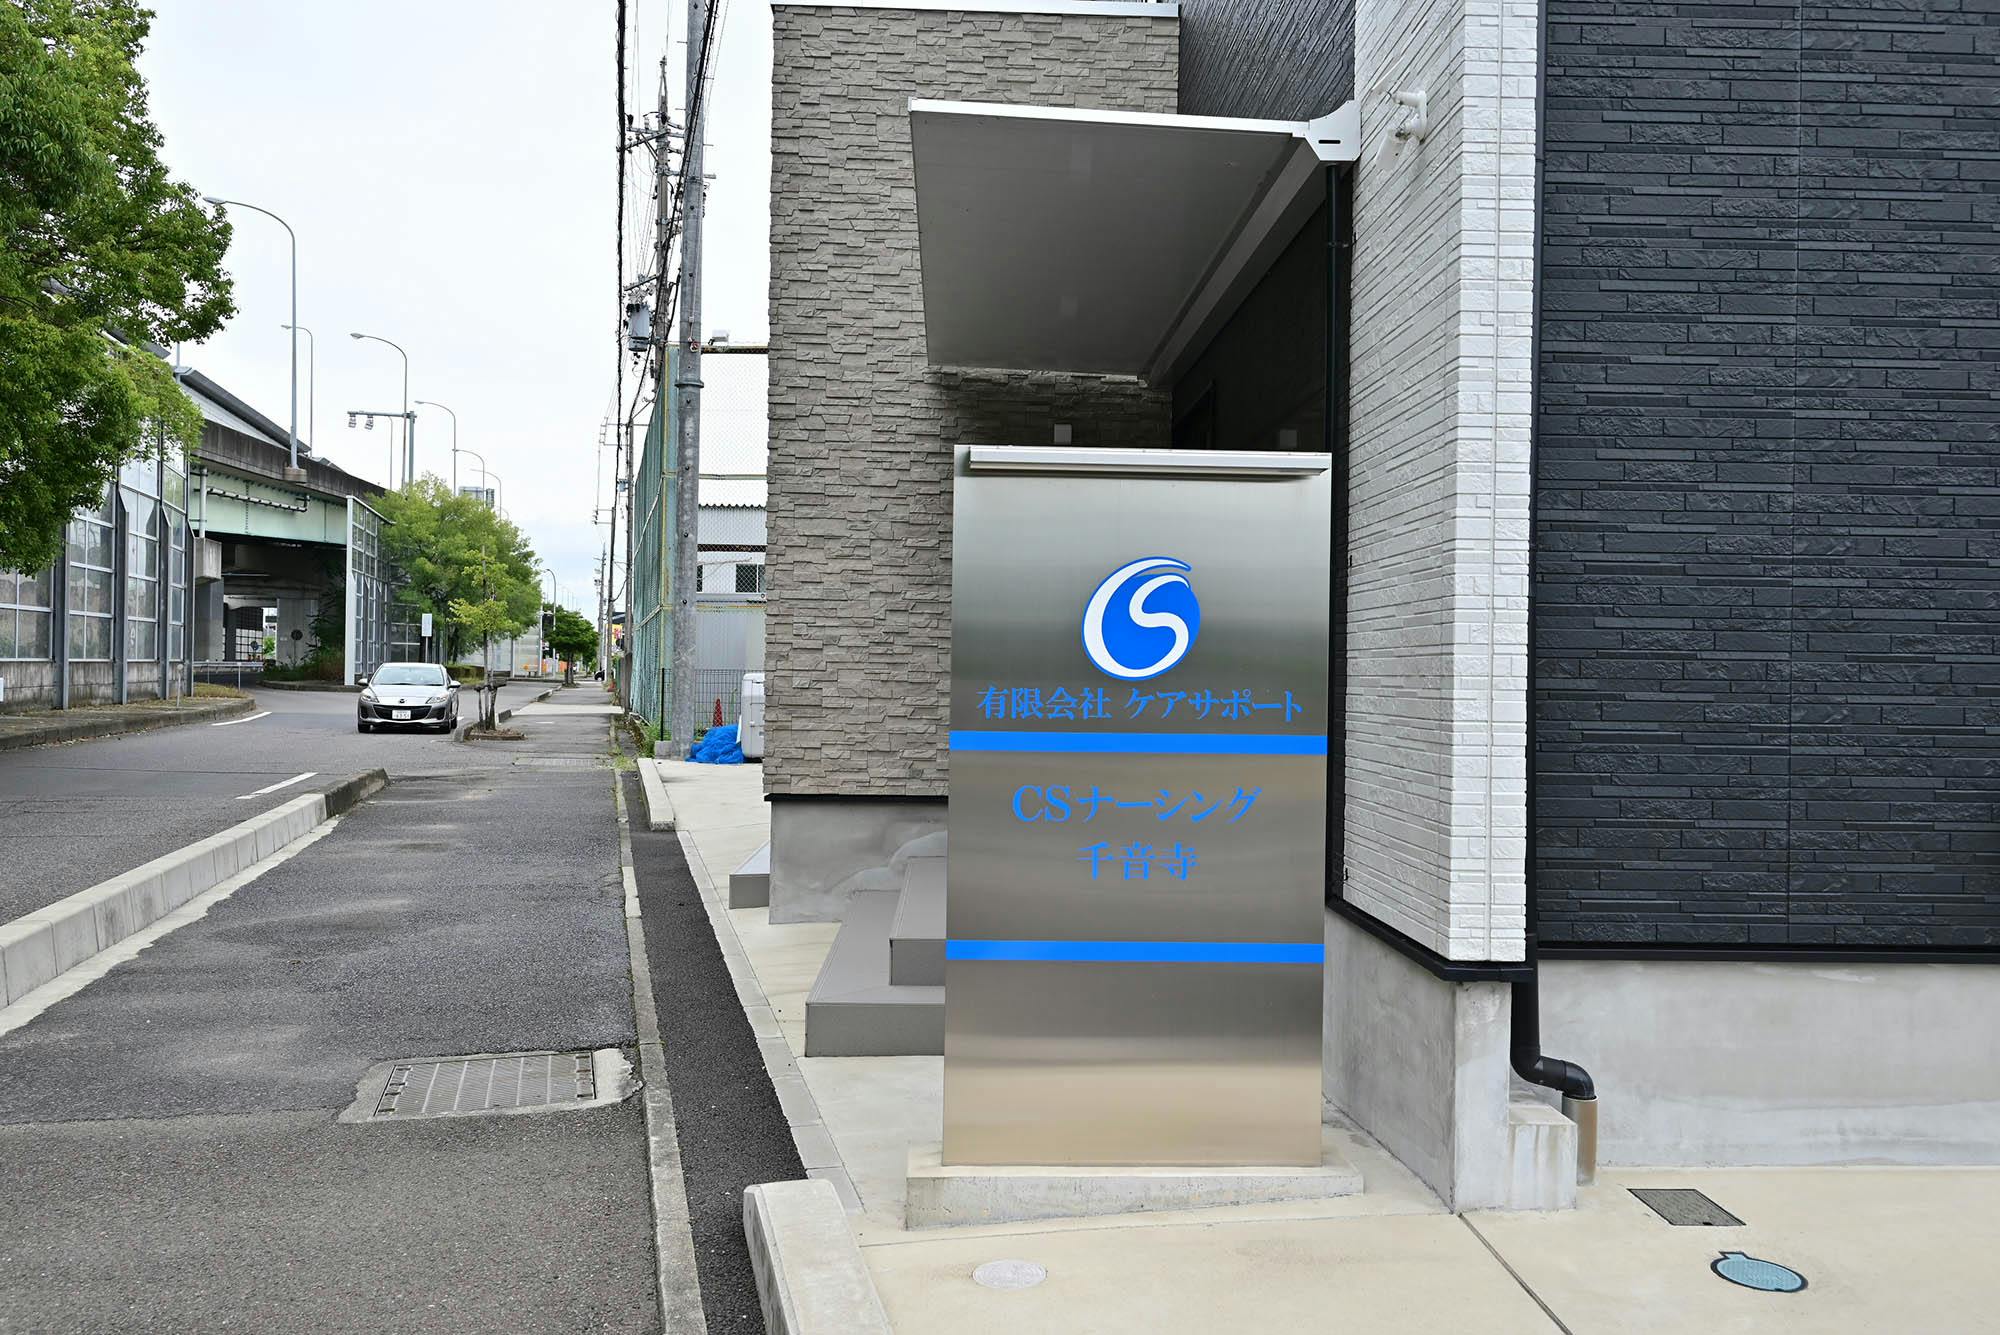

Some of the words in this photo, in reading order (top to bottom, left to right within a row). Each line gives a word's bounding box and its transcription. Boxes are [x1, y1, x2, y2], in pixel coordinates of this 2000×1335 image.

[976, 686, 1112, 720] 有限会社
[1124, 687, 1303, 722] ケアサポート
[1012, 785, 1263, 824] CSナーシング
[1076, 841, 1200, 881] 千音寺
